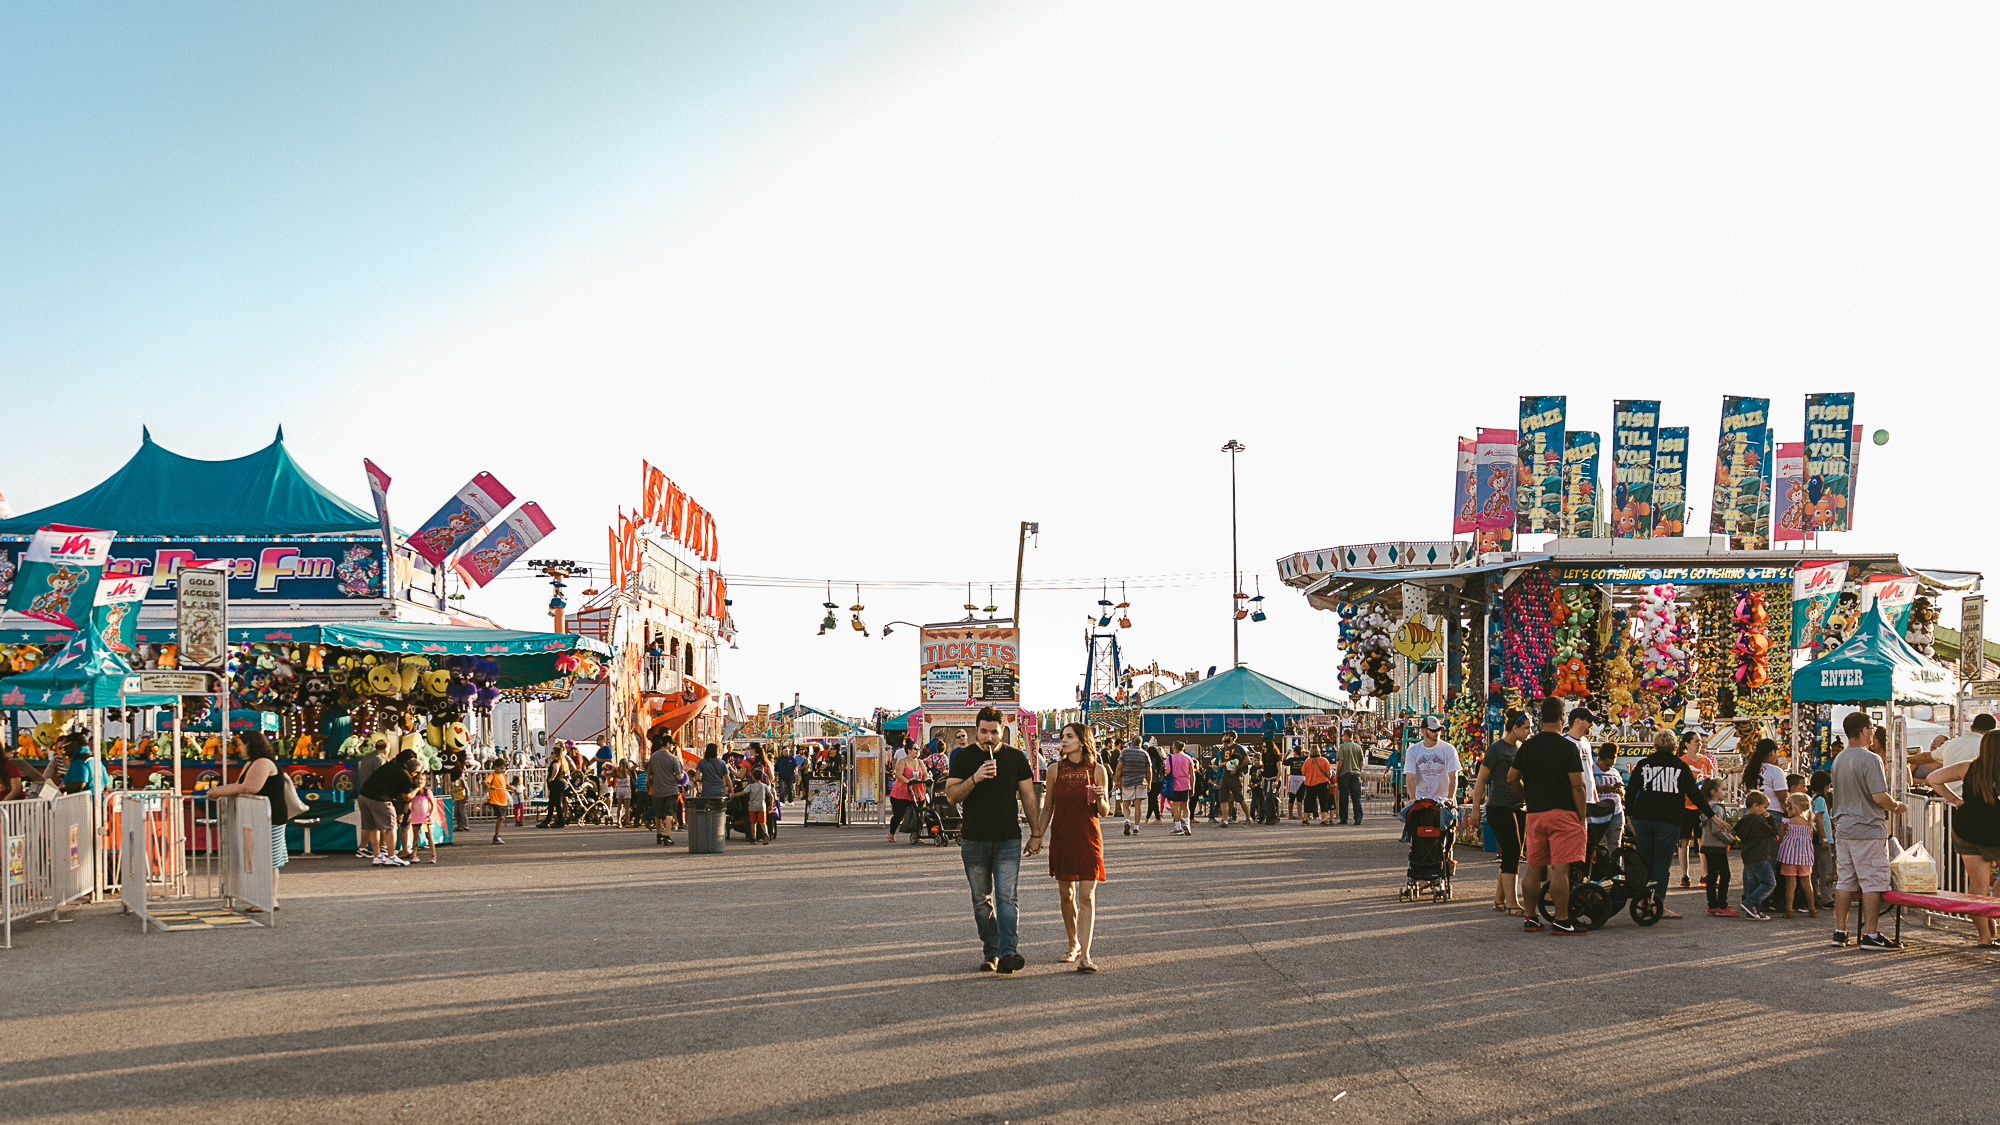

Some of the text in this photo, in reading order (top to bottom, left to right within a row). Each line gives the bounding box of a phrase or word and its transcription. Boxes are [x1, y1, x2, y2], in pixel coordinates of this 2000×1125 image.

[1521, 407, 1563, 433] PRIZE
[1617, 411, 1655, 428] FISH
[1808, 405, 1849, 420] FISH
[1723, 410, 1765, 433] PRIZE
[1618, 431, 1652, 446] TILL
[1810, 424, 1847, 439] TILL
[1657, 438, 1685, 453] ISH
[1810, 442, 1845, 457] YOU
[1618, 448, 1651, 464] YOU
[1657, 455, 1682, 469] ILL
[1615, 467, 1652, 483] WIN!
[1807, 460, 1847, 476] WIN!
[1528, 432, 1548, 530] EVERYTIME
[1722, 432, 1748, 532] EVERYTIME
[254, 547, 335, 592] Fun
[1564, 569, 1589, 579] LET'S
[1591, 569, 1606, 580] GO
[1606, 569, 1646, 580] FISHING
[1663, 568, 1688, 580] LET'S
[1690, 569, 1706, 579] GO
[1707, 569, 1745, 579] FISHING
[1761, 568, 1787, 579] LET'S
[189, 578, 215, 586] GOLD
[182, 601, 220, 610] LANE
[1963, 613, 1980, 621] ACCESS
[925, 642, 1015, 662] TICKETS
[1821, 669, 1863, 686] ENTER
[1175, 717, 1263, 728] SOFT SERV
[1627, 747, 1641, 756] GO
[1642, 766, 1682, 794] PINK
